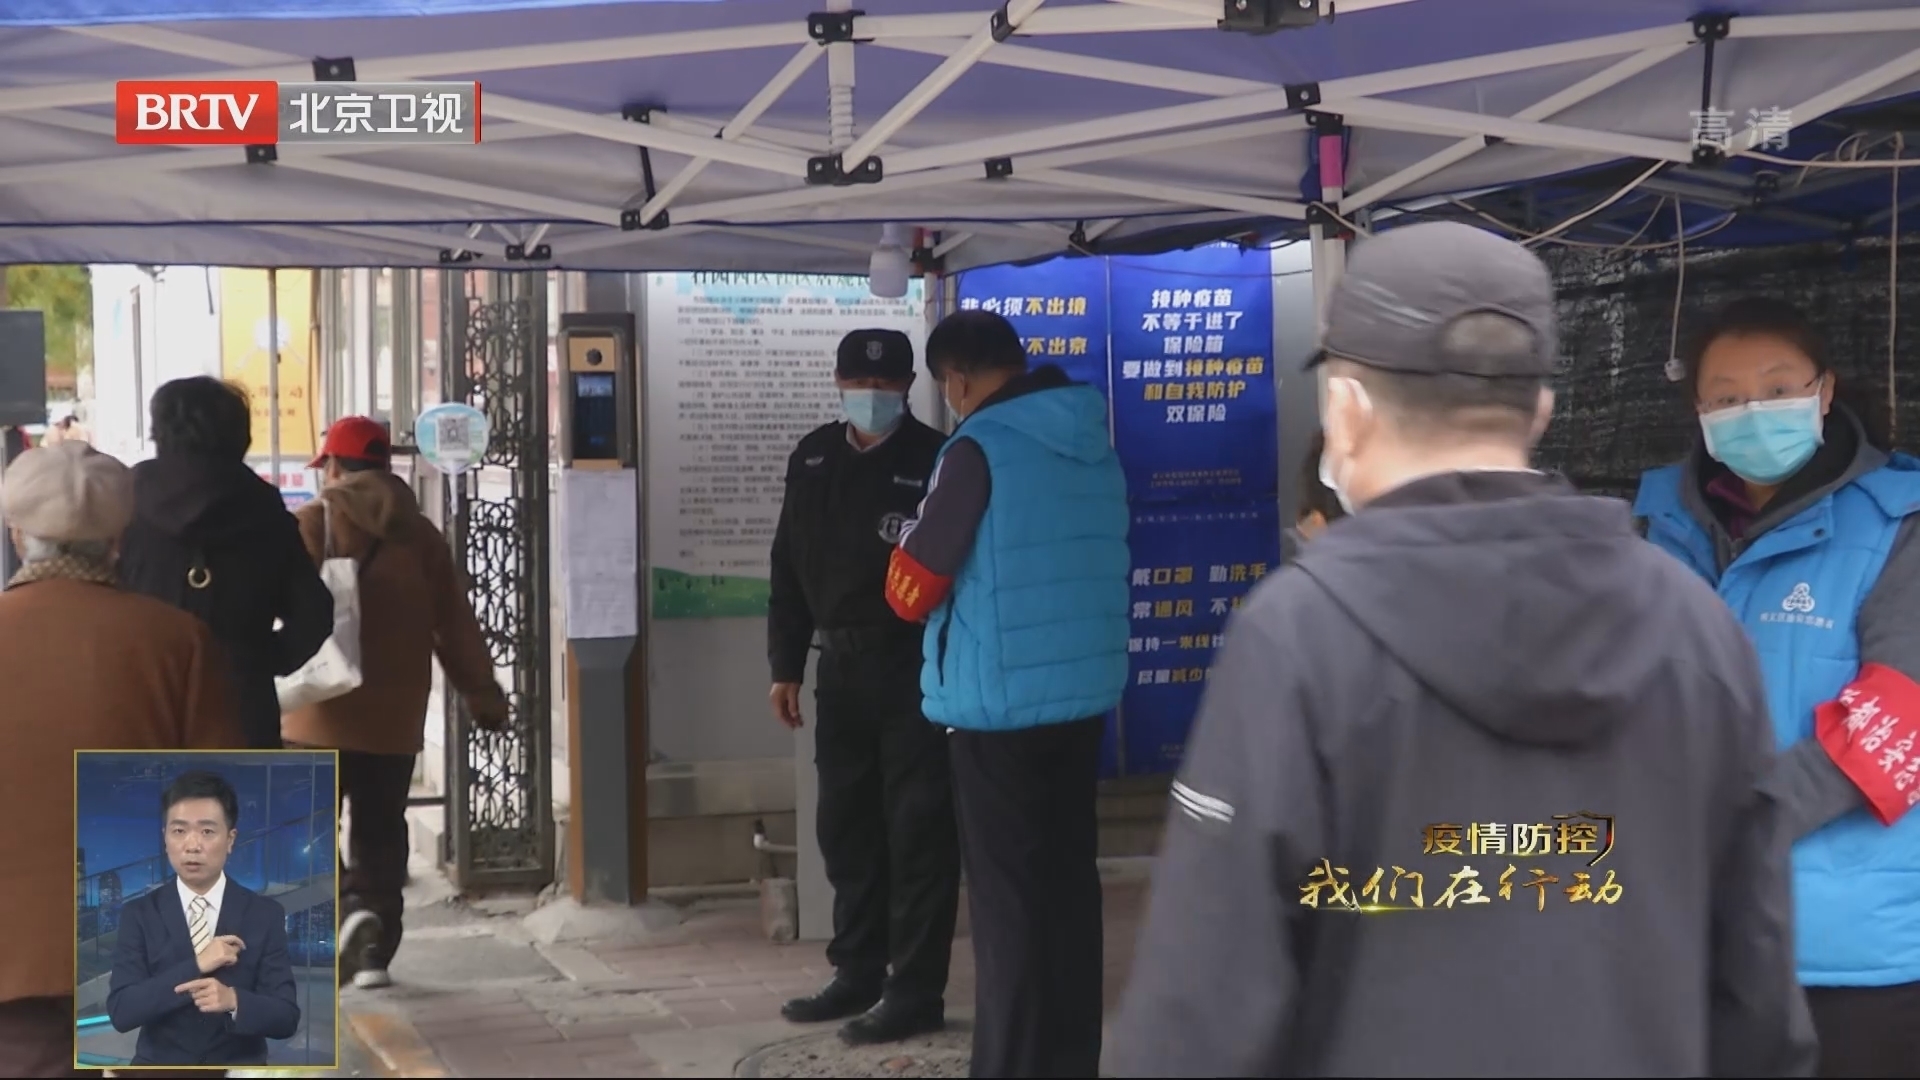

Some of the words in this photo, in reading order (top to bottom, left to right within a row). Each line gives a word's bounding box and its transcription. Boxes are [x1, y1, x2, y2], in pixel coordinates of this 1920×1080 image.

[1151, 288, 1232, 309] 接种疫苗
[1142, 311, 1243, 332] 不等于进了
[1019, 337, 1088, 356] 不出京
[1163, 334, 1224, 354] 保险箱
[1122, 357, 1265, 379] 要做到接种疫苗
[1143, 380, 1246, 401] 和自我防护
[1166, 404, 1226, 424] 双保险
[1131, 566, 1194, 587] 戴口罩
[1137, 668, 1212, 686] 尽量减少
